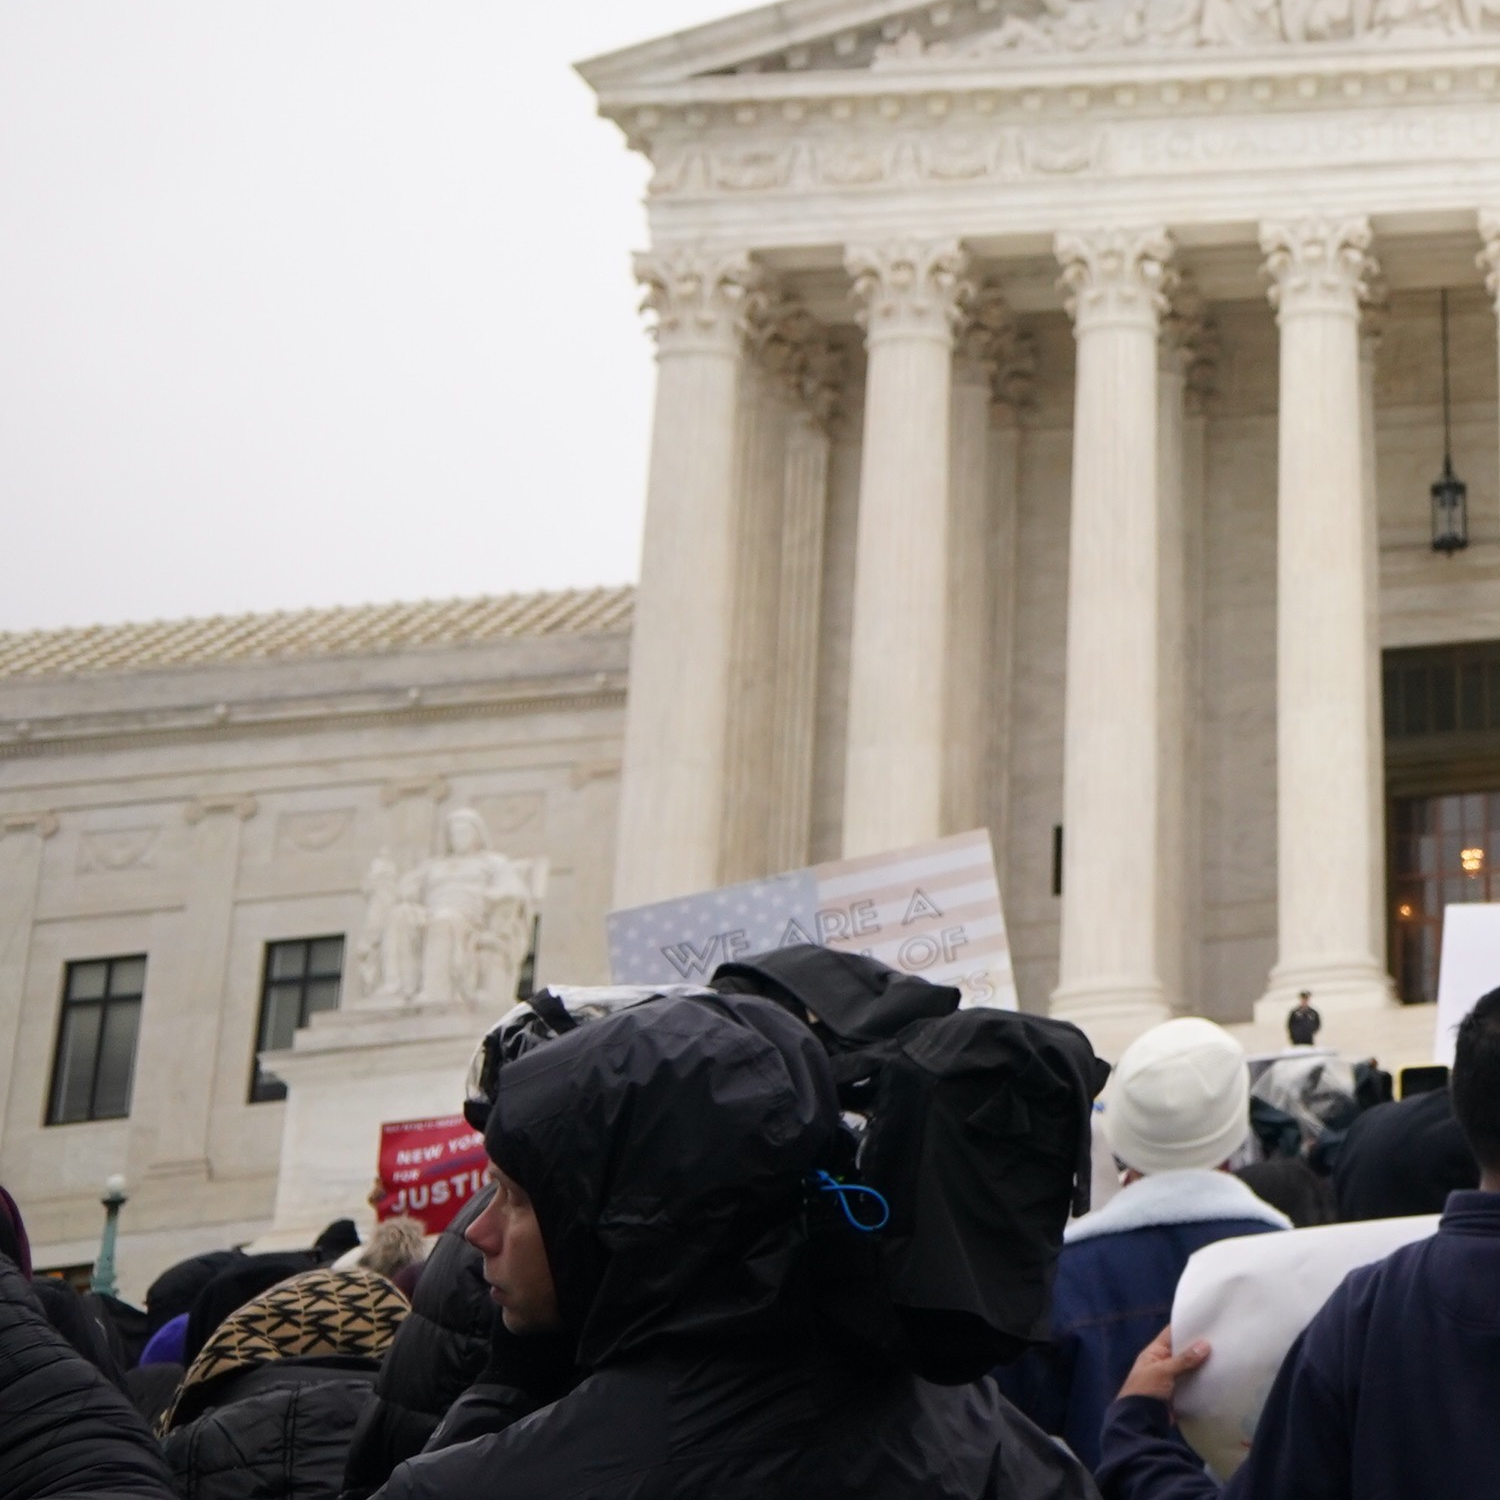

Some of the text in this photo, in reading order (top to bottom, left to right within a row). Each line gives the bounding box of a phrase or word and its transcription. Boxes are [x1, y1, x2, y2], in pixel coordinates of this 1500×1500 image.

[660, 887, 943, 978] WE ARE A
[897, 925, 969, 972] OF
[396, 1143, 444, 1165] NEW
